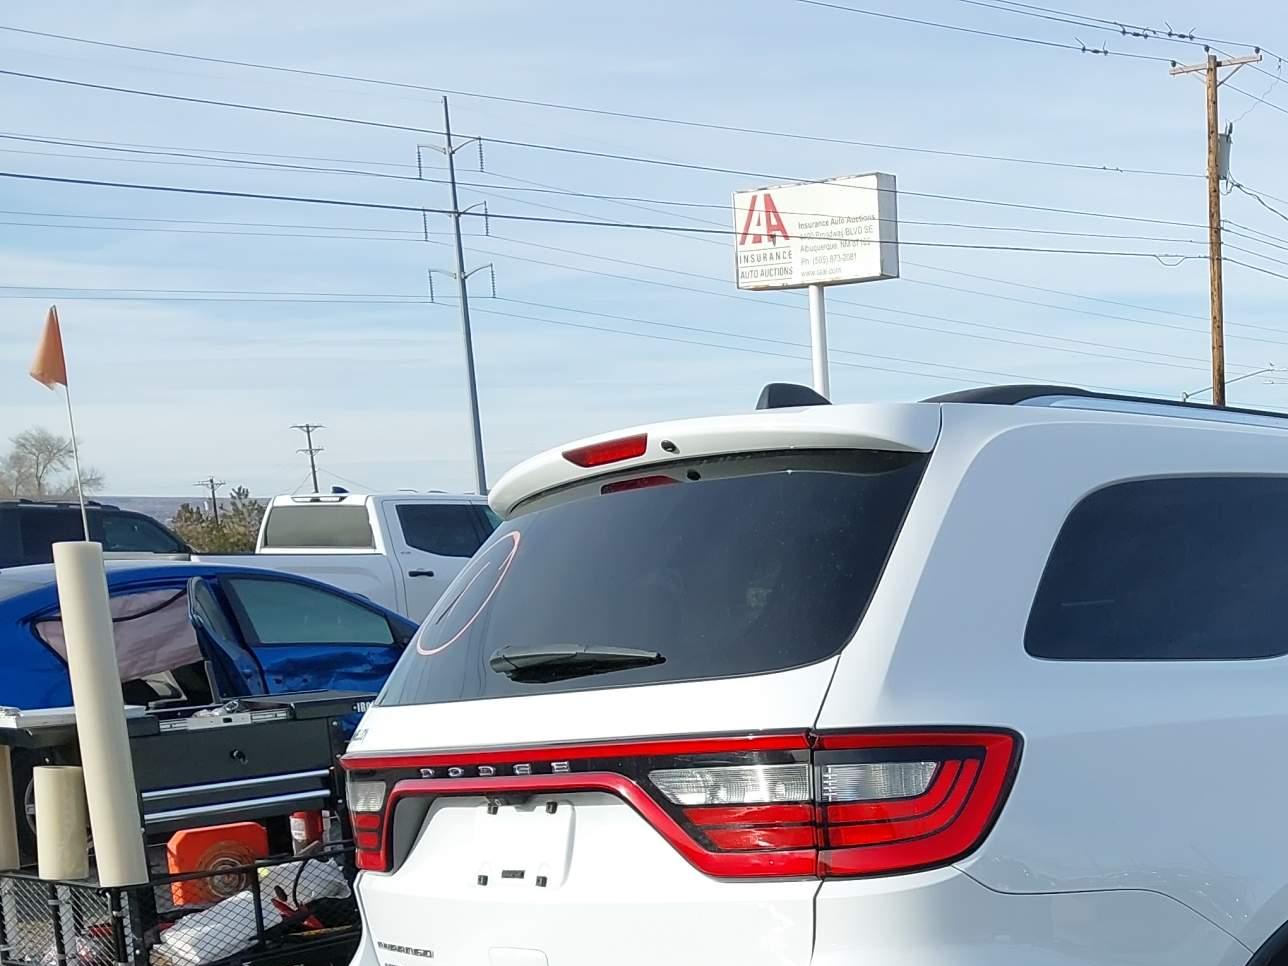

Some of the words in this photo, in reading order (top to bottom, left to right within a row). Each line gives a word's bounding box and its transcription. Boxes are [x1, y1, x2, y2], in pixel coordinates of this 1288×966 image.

[798, 220, 829, 230] Insurance
[830, 216, 845, 226] Auto
[739, 250, 793, 264] INSURANCE
[740, 269, 759, 280] AUTO
[760, 266, 793, 278] AUCTIONS
[420, 760, 571, 778] DODGE
